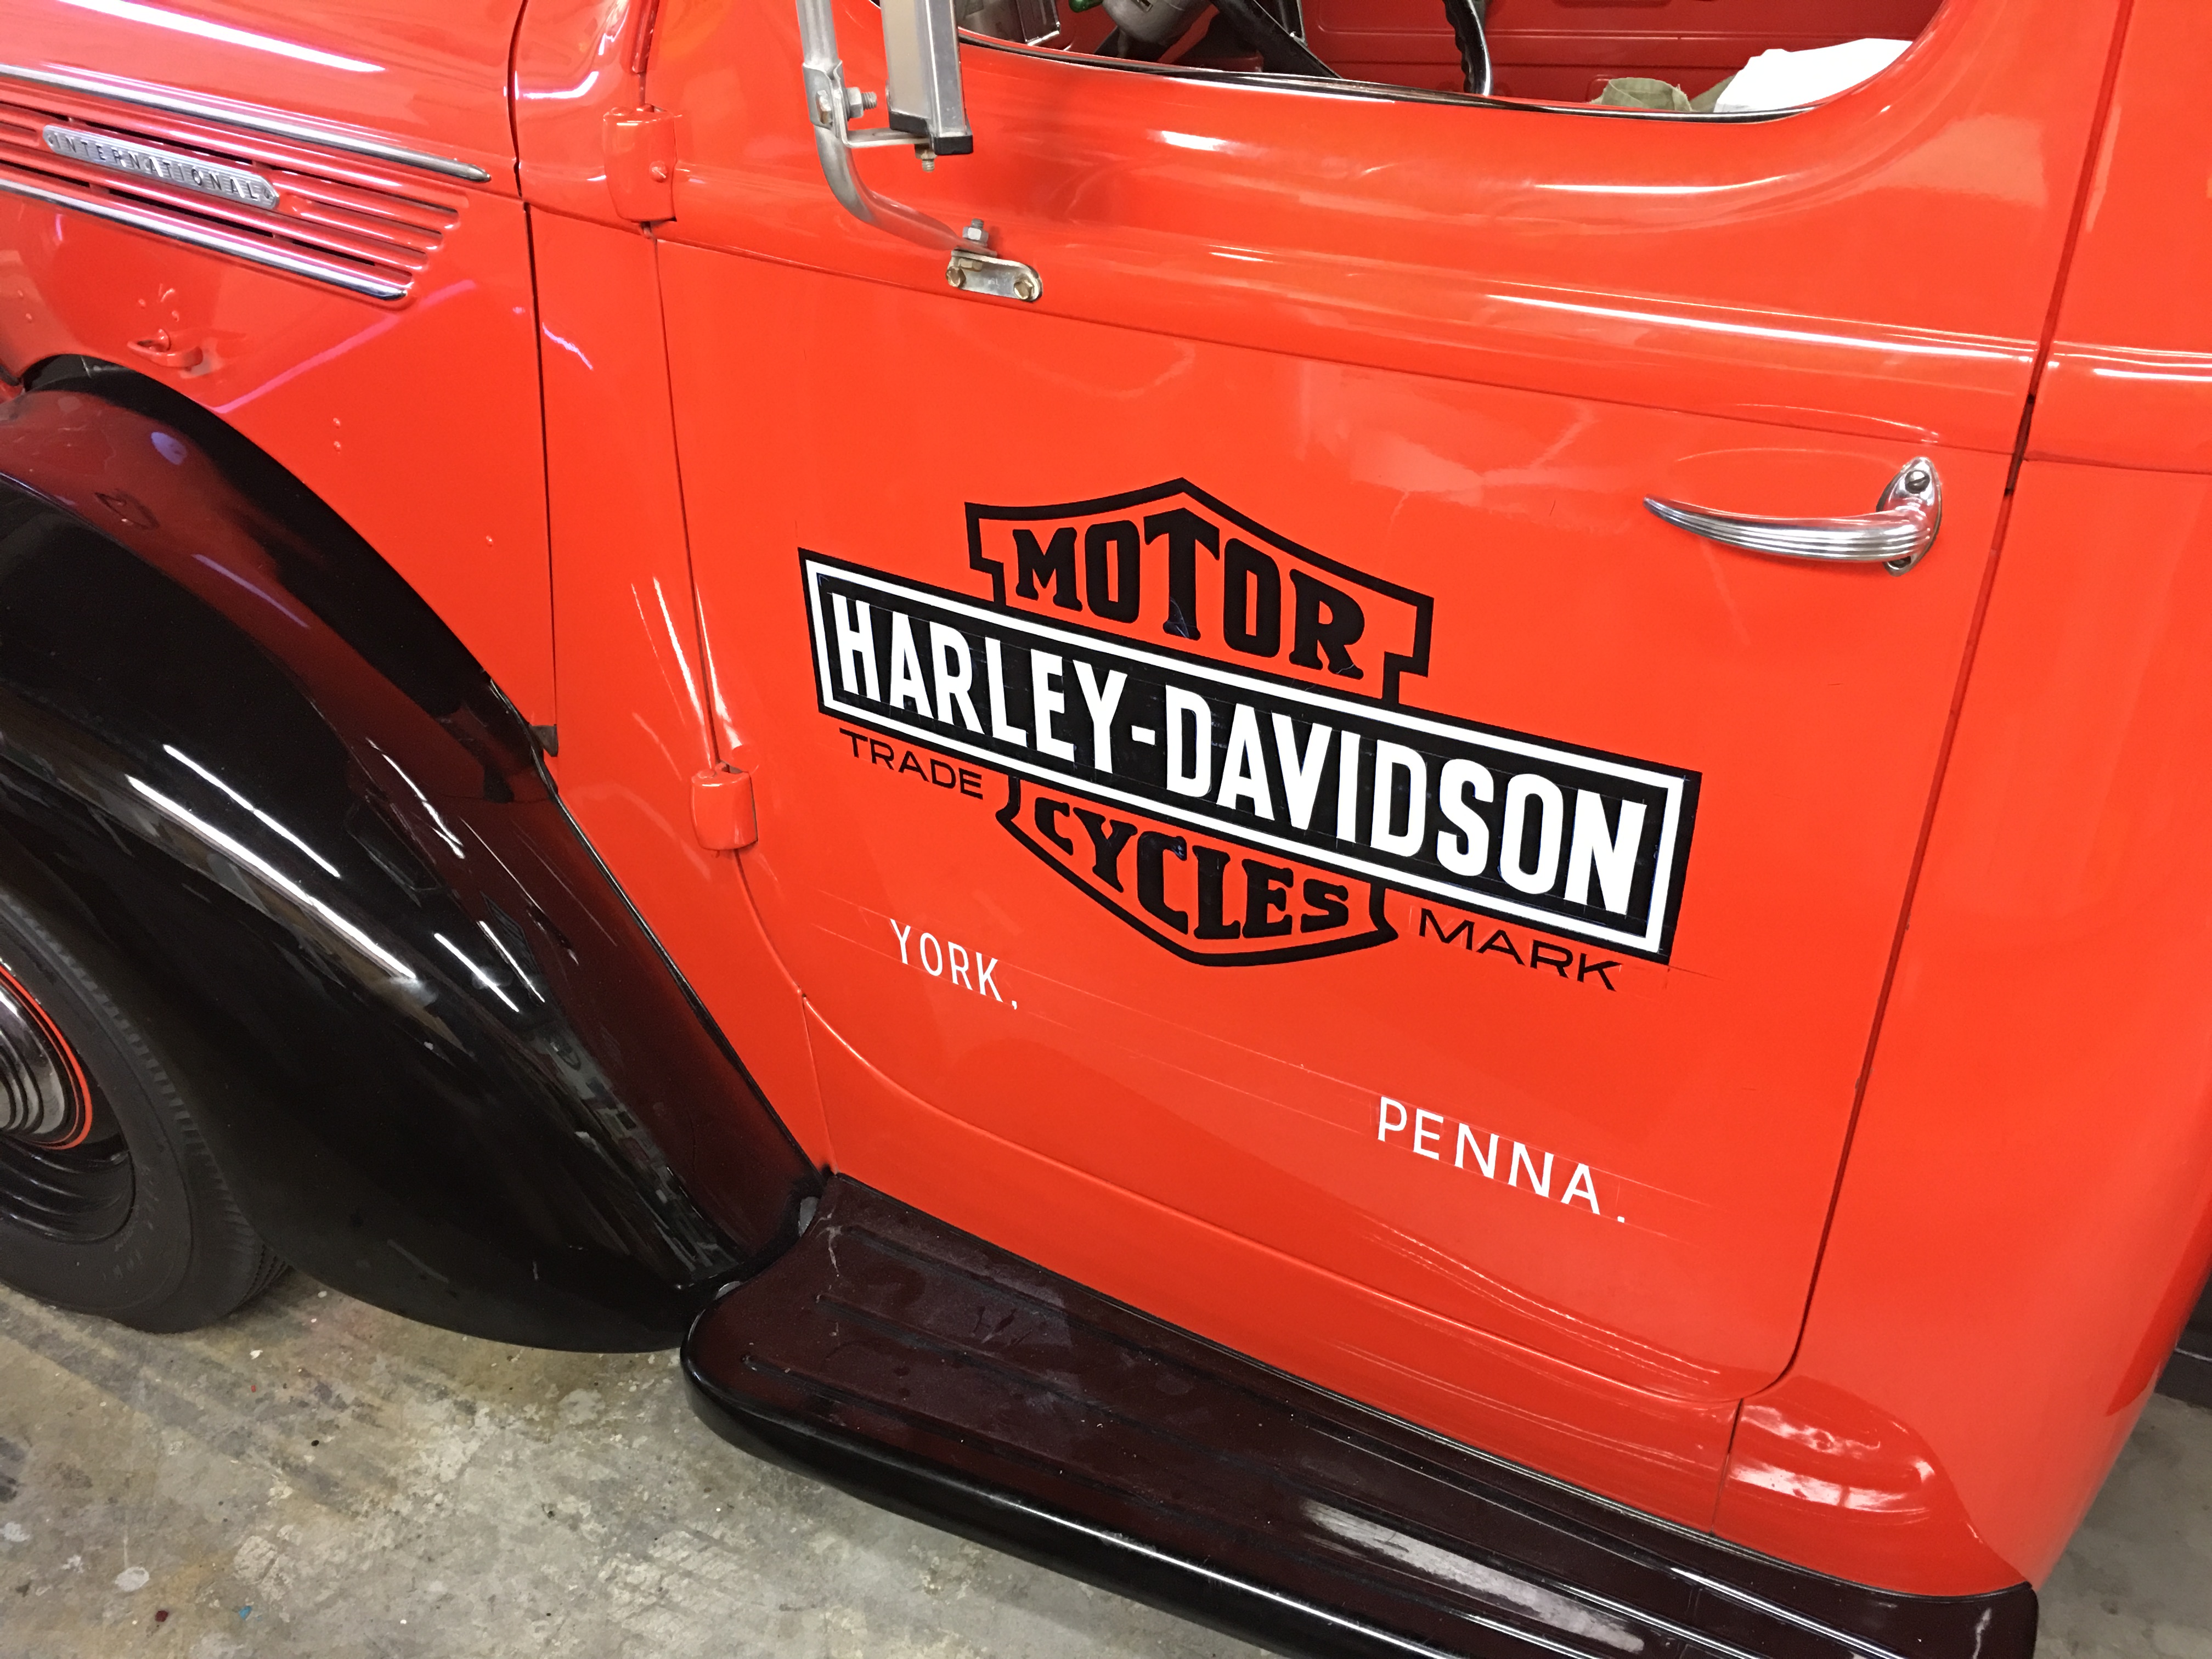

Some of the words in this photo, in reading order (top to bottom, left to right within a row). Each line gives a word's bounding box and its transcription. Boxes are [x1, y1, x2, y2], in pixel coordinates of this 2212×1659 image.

[54, 133, 259, 201] INTERNATIONAL
[1012, 507, 1364, 679] MOTOR
[832, 592, 1647, 915] HARLEY-DAVIDSON
[839, 727, 984, 799] TRADE
[1419, 908, 1621, 991] MARK
[1035, 802, 1350, 940] CYCLES
[890, 918, 1018, 1010] YORK,
[1378, 1096, 1625, 1223] PENNA.
